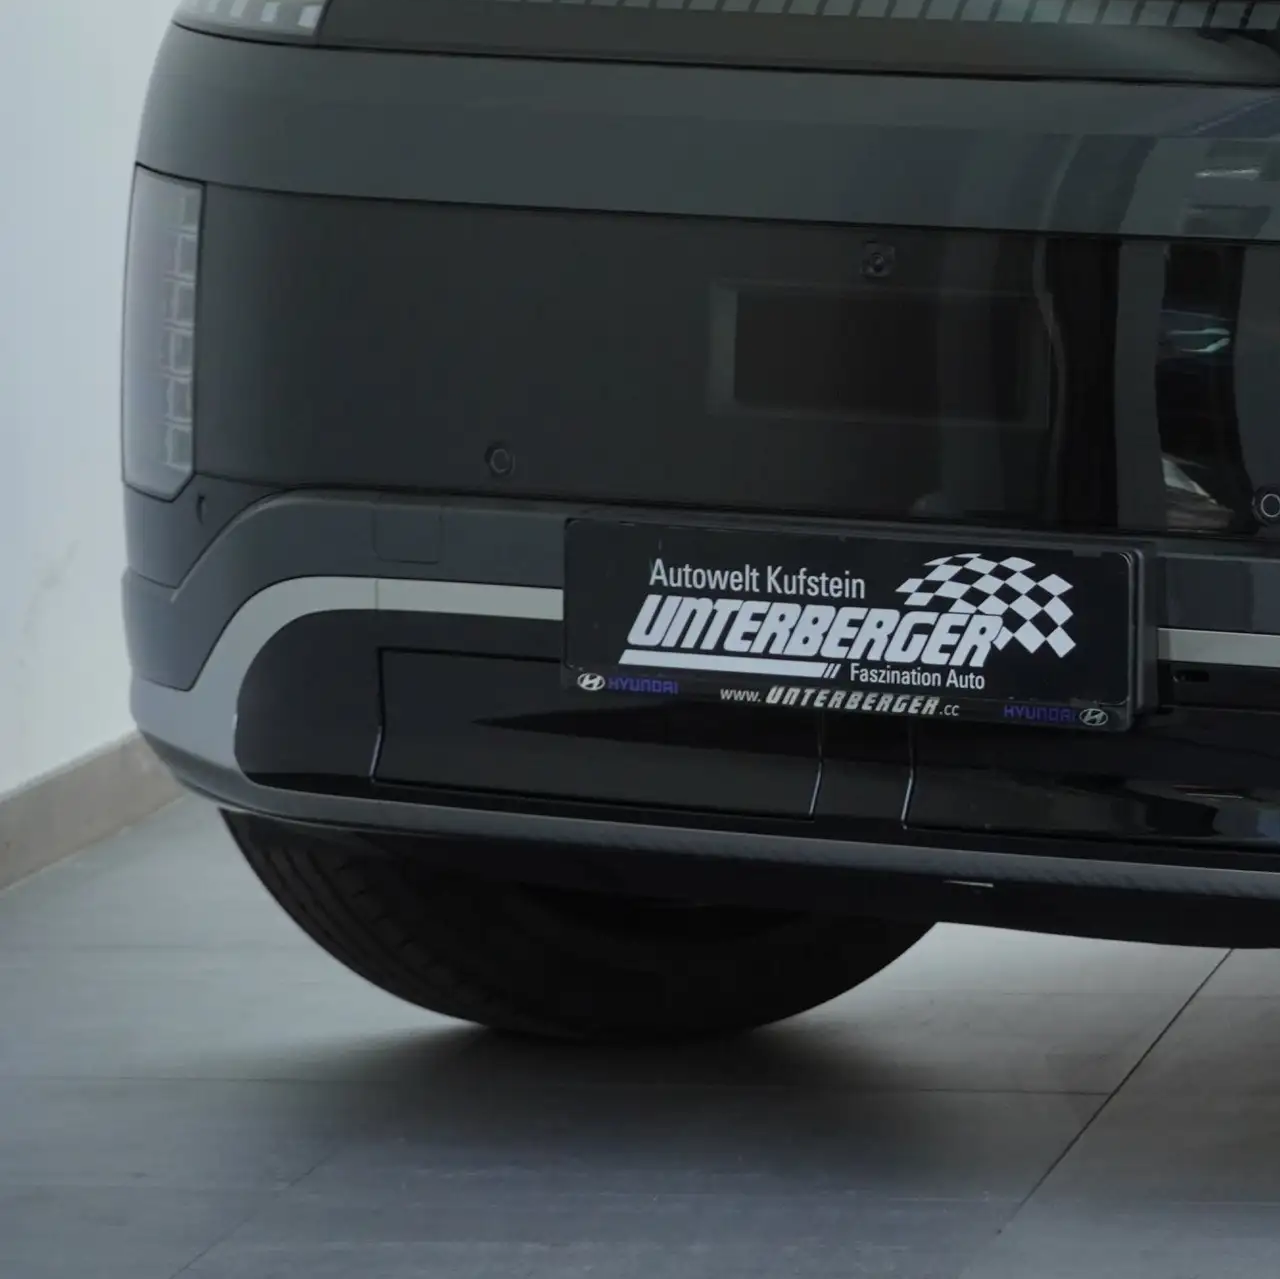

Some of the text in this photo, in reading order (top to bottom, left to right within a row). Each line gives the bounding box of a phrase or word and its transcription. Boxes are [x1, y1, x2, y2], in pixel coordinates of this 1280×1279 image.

[649, 557, 866, 600] Autowelt Kufstein
[627, 593, 1004, 668] UNTERBERGER
[607, 676, 679, 695] HYUNDAI
[850, 662, 986, 690] Faszination Auto
[1004, 704, 1076, 724] HYUNDAI
